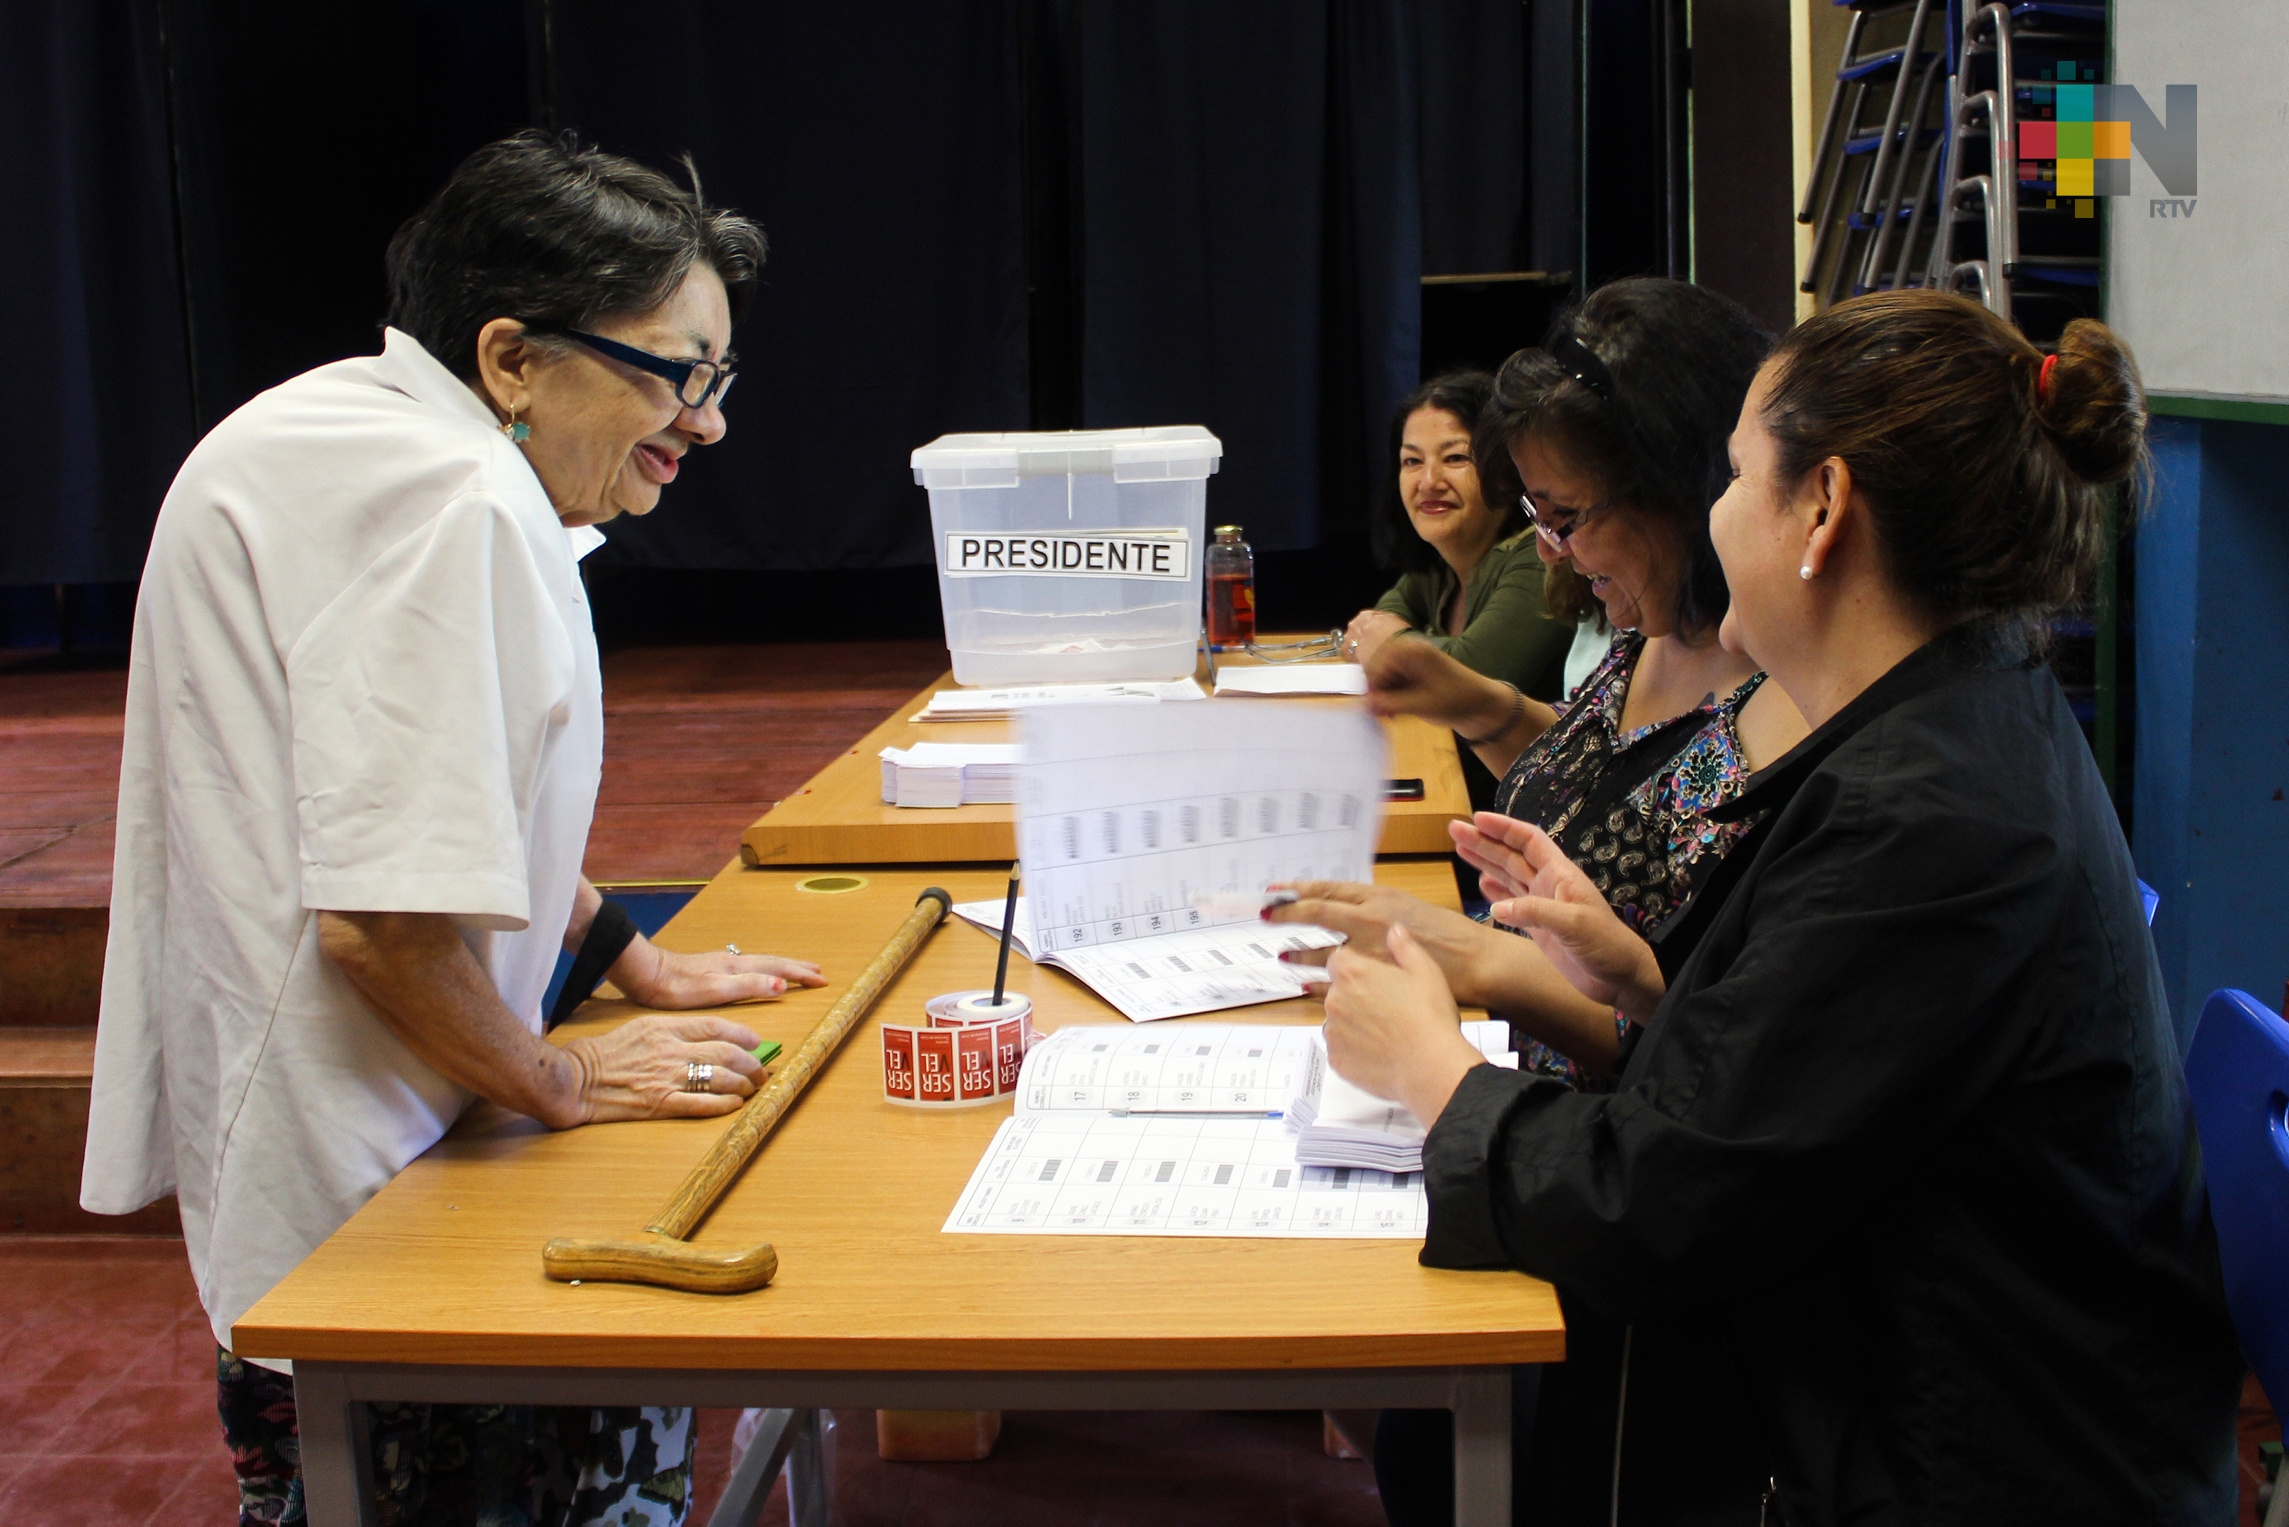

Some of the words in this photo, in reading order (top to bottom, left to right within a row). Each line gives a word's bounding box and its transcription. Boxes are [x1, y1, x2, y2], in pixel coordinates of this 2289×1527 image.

[961, 539, 1171, 573] PRESIDENTE
[1151, 916, 1161, 930] 194
[1189, 910, 1200, 924] 195
[1072, 928, 1083, 943] 192
[1112, 922, 1122, 936] 193
[886, 1049, 911, 1070] VEL
[920, 1053, 950, 1073] VEL
[961, 1050, 991, 1071] VEL
[887, 1070, 912, 1091] SER
[922, 1073, 951, 1093] SER
[963, 1069, 991, 1091] SER
[1073, 1091, 1087, 1101] 17
[1127, 1091, 1140, 1101] 18
[1181, 1092, 1193, 1102] 19
[1234, 1092, 1247, 1102] 20
